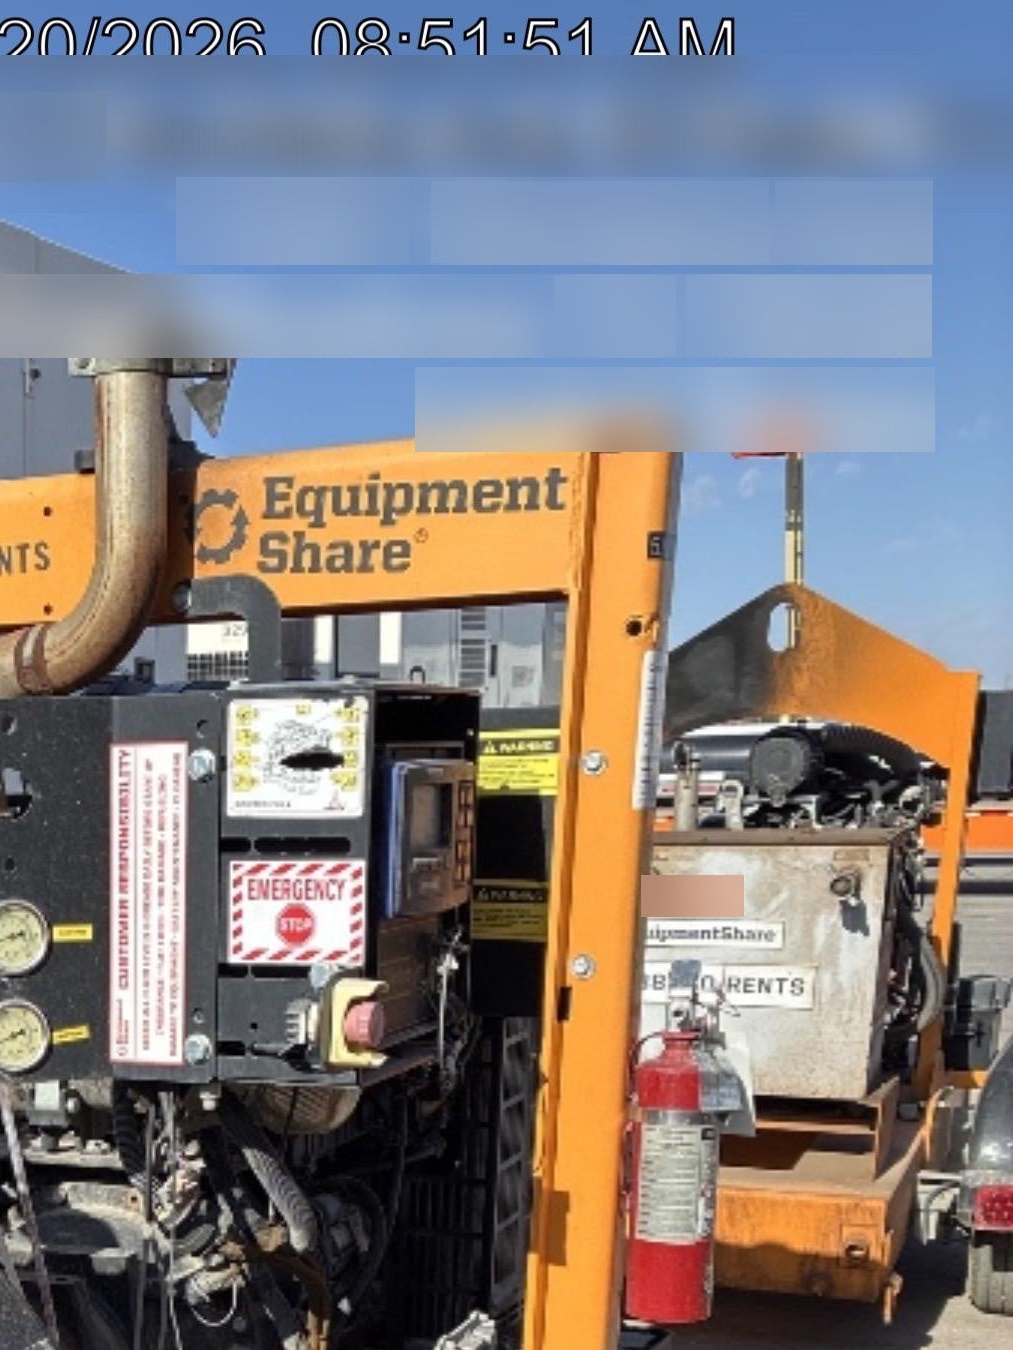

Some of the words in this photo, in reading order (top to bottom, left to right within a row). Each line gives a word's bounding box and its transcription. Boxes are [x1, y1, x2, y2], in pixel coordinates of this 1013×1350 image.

[263, 468, 569, 528] Equipment
[257, 530, 412, 574] Share
[247, 878, 346, 901] EMERGENCY
[278, 917, 311, 933] STOP
[727, 976, 806, 997] RENTS
